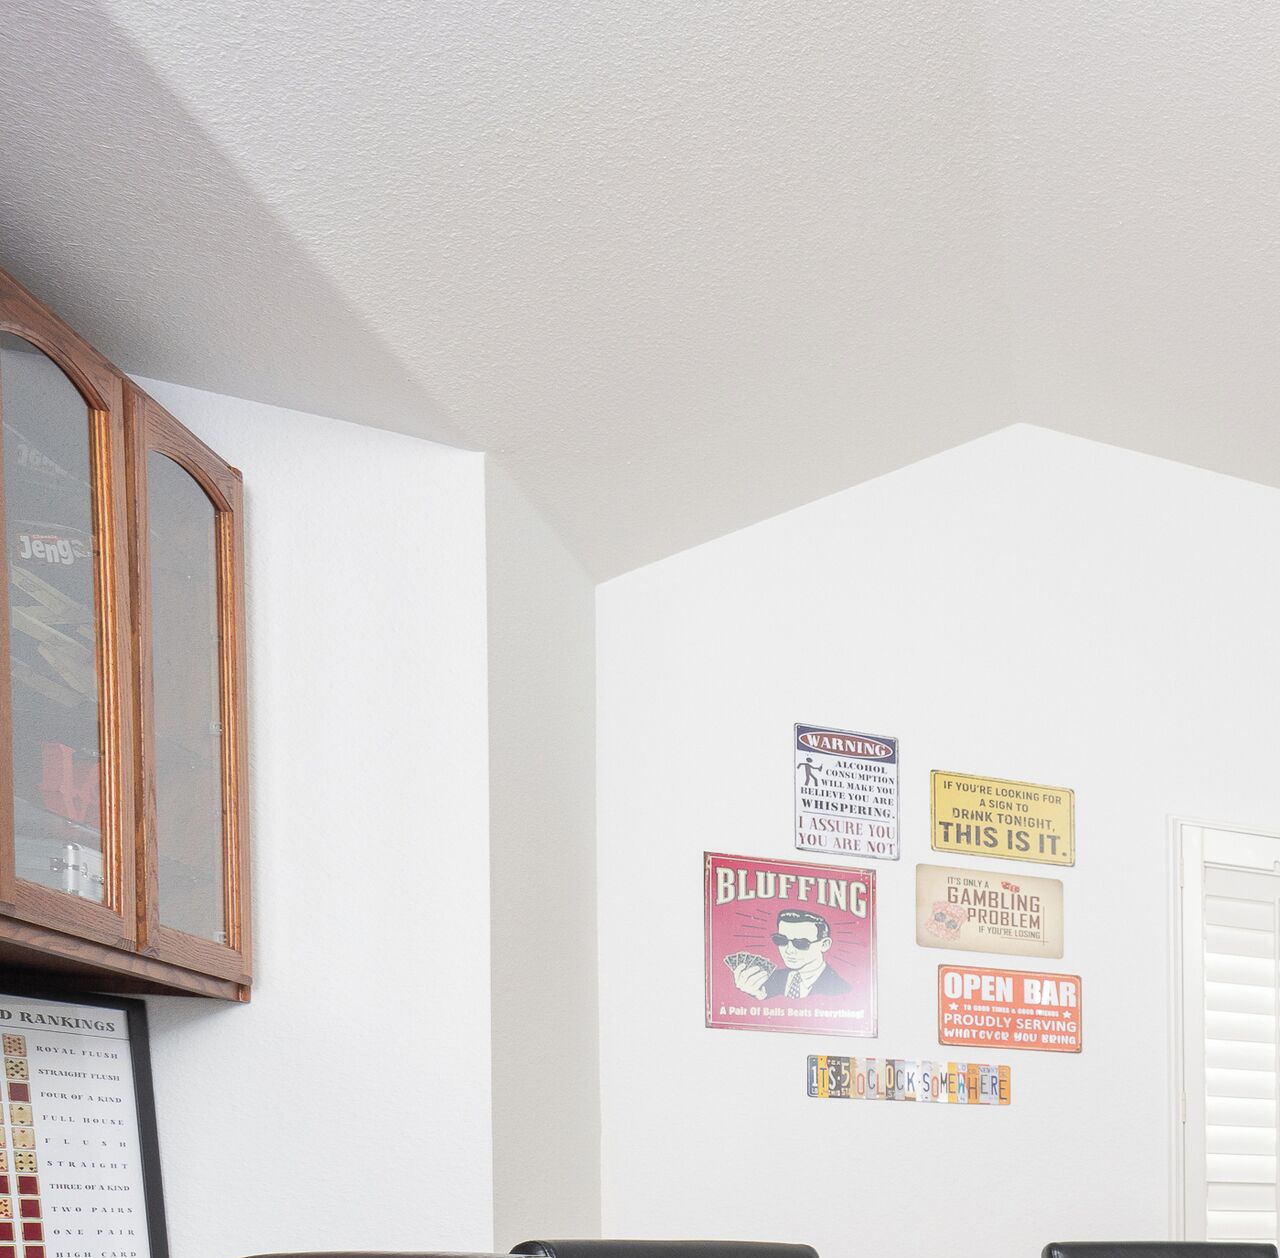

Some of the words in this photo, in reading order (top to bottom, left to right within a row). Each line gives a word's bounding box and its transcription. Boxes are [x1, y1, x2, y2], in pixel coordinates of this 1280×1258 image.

[806, 733, 886, 756] WARNING
[826, 769, 895, 785] CONSUMPTION
[835, 761, 887, 774] ALCOHOL
[801, 786, 846, 800] BELIEVE
[848, 793, 869, 802] YOU
[873, 797, 894, 806] ARE
[821, 779, 845, 788] WILL
[847, 782, 874, 793] MAKE
[876, 785, 895, 795] YOU
[943, 780, 953, 789] IF
[956, 782, 993, 796] YOU'RE
[995, 787, 1040, 801] LOOKING
[1042, 794, 1062, 805] FOR
[802, 798, 895, 819] WHISPERING.
[979, 798, 986, 807] A
[988, 799, 1013, 810] SIGN
[1016, 803, 1029, 813] TO
[799, 816, 803, 828] I
[810, 817, 863, 836] ASSURE
[869, 824, 895, 839] YOU
[952, 807, 993, 823] DRINK
[997, 813, 1056, 832] TONIGHT,
[799, 832, 827, 847] YOU
[833, 837, 860, 851] ARE
[867, 841, 896, 855] NOT
[938, 821, 999, 848] THIS
[1007, 829, 1030, 852] IS
[1039, 833, 1067, 857] IT.
[947, 876, 961, 885] IT'S
[963, 878, 983, 888] ONLY
[984, 881, 989, 889] A
[715, 866, 868, 919] BLUFFING
[947, 886, 1040, 913] GAMBLING
[967, 907, 1040, 930] PROBLEM
[978, 926, 985, 934] IF
[987, 927, 1013, 937] YOU'RE
[1014, 930, 1040, 939] LOSING
[943, 972, 1014, 1003] OPEN
[1023, 978, 1077, 1008] BAR
[720, 1006, 726, 1015] A
[729, 1006, 748, 1016] Pair
[750, 1006, 760, 1016] Of
[764, 1008, 785, 1017] Balls
[787, 1008, 812, 1017] Beats
[20, 1011, 116, 1032] RANKINGS
[944, 1013, 1012, 1028] PROUDLY
[1015, 1018, 1077, 1032] SERVING
[944, 1028, 1009, 1041] WHATEVER
[1013, 1032, 1037, 1042] YOU
[1041, 1034, 1076, 1045] BRING
[36, 1045, 76, 1055] ROYAL
[82, 1050, 118, 1060] FLUSH
[38, 1068, 87, 1079] STRAIGHT
[91, 1073, 120, 1081] FLUSH
[40, 1091, 67, 1099] FOUR
[42, 1114, 75, 1123] FULL
[83, 1117, 124, 1126] HOUSE
[47, 1160, 128, 1169] STRAIGHT
